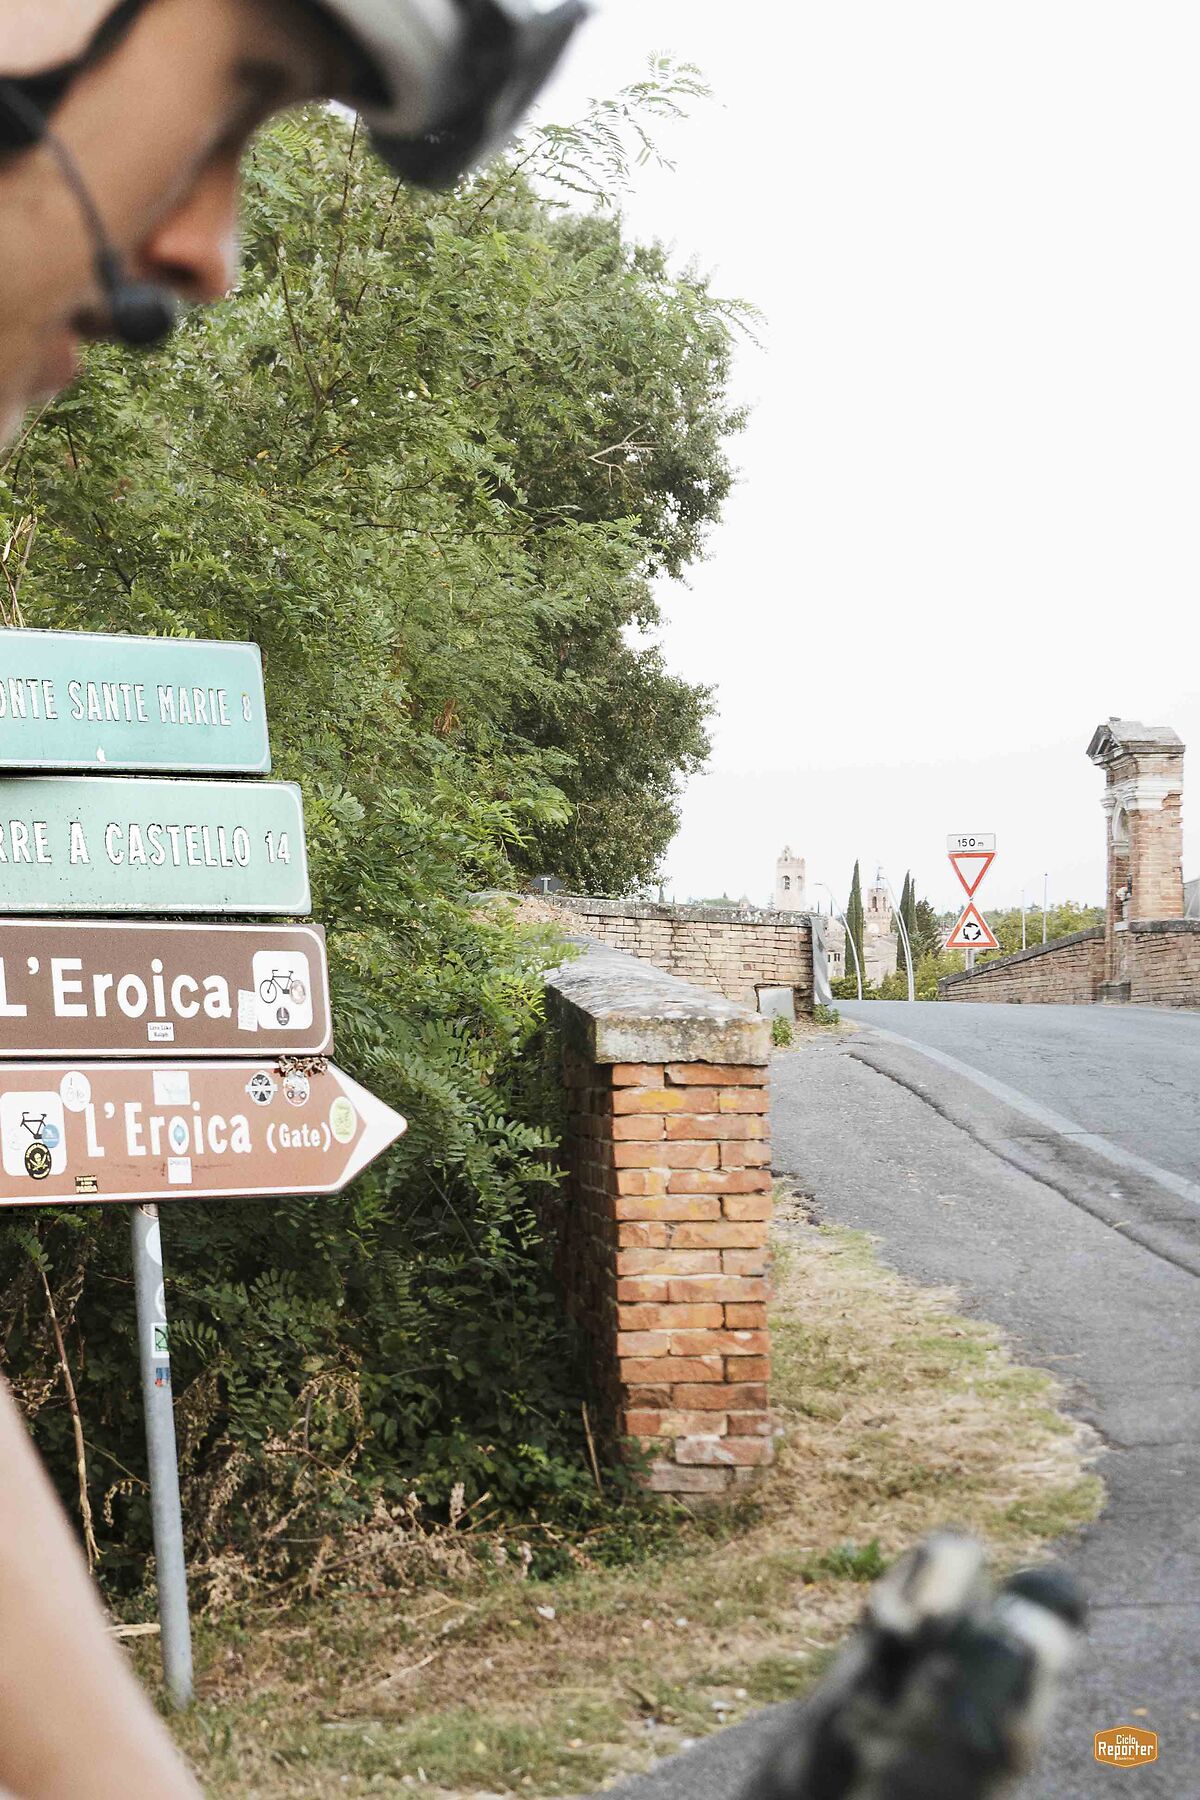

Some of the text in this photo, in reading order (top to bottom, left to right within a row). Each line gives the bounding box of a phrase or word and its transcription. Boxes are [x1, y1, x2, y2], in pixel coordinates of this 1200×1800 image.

[67, 679, 149, 722] SANTE
[156, 684, 231, 726] MARIE
[241, 692, 252, 723] 8
[69, 821, 91, 865] A
[104, 822, 251, 868] CASTELLO
[265, 830, 291, 865] 14
[957, 838, 976, 847] 150
[84, 1101, 332, 1157] L'Eroica (Gate)
